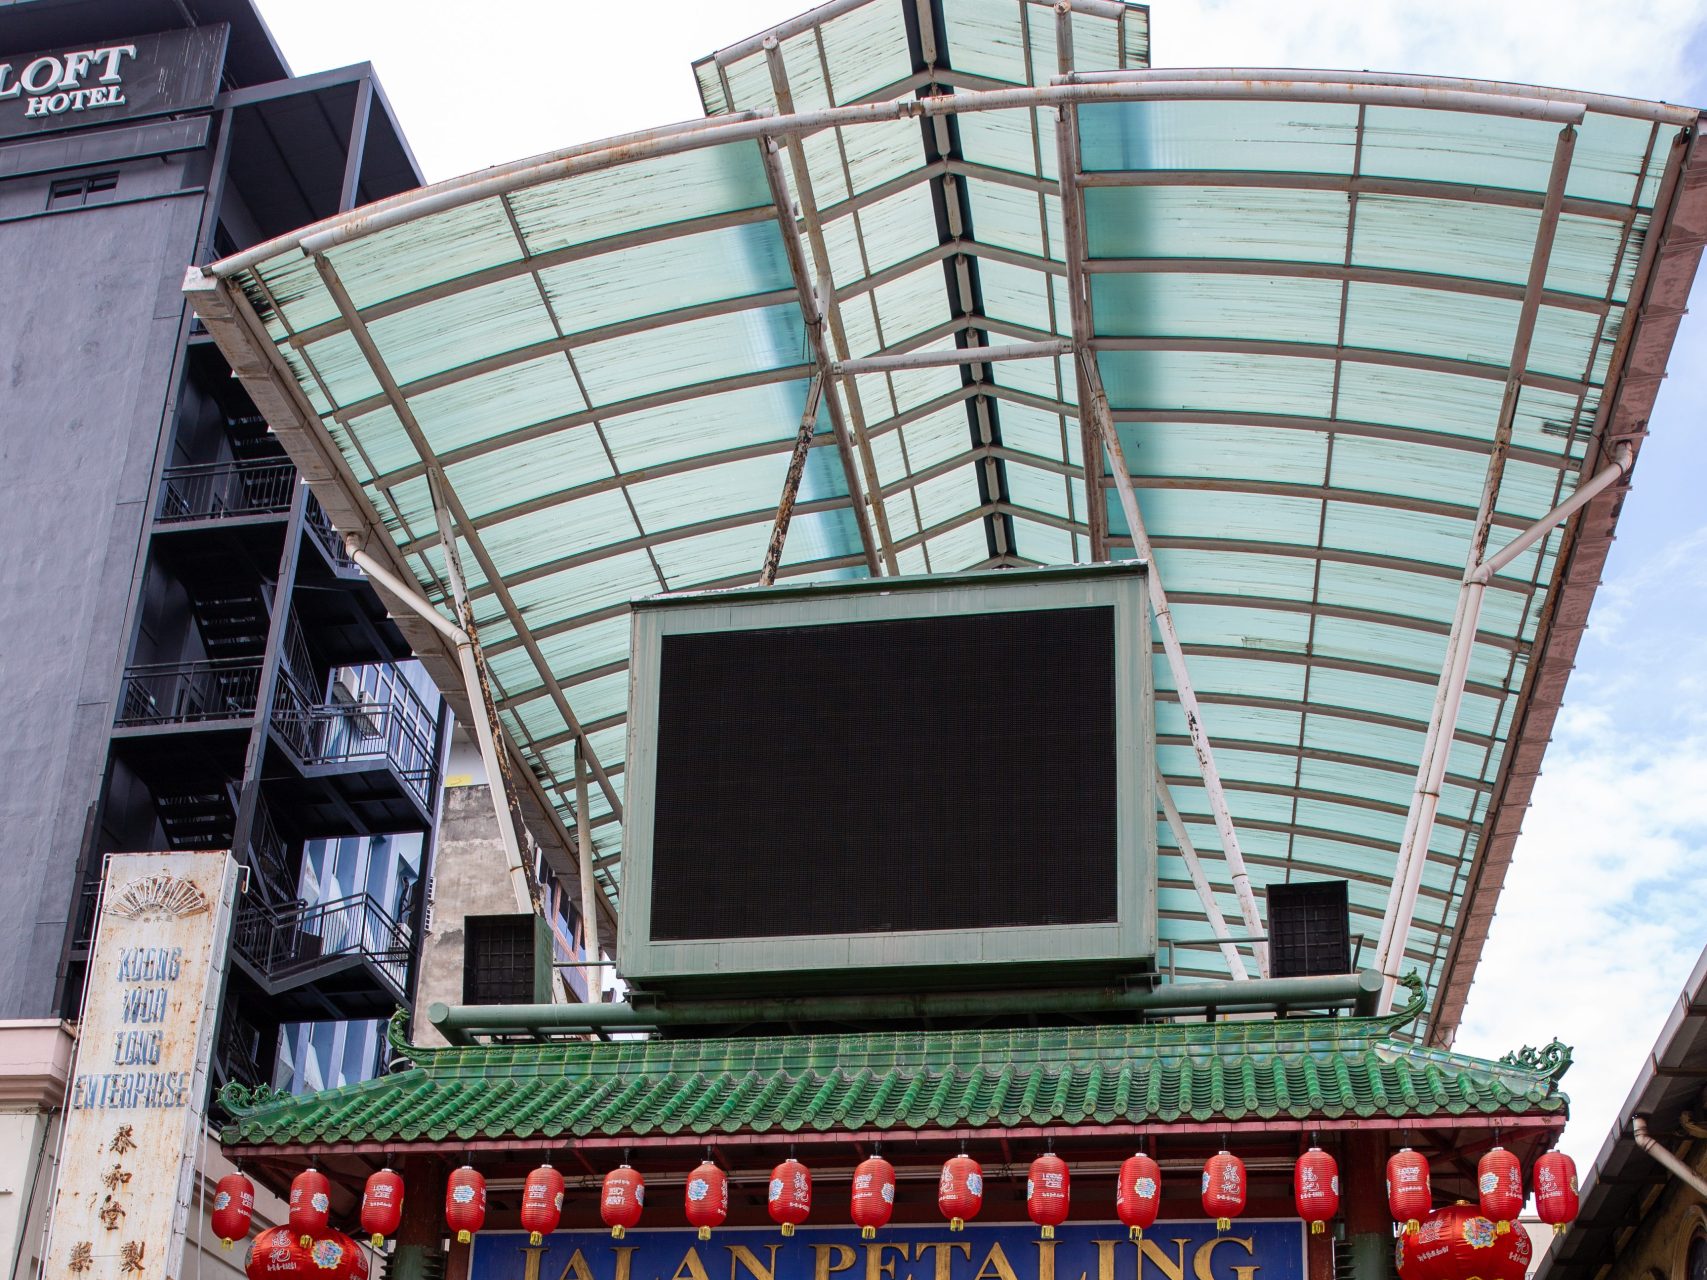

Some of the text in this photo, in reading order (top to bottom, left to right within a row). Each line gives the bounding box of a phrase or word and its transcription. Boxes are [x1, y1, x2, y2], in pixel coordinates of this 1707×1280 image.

[25, 86, 125, 118] HOTEL
[118, 947, 182, 982] KOONG
[123, 987, 168, 1023] WOH
[74, 1072, 190, 1109] ENTERPRISE
